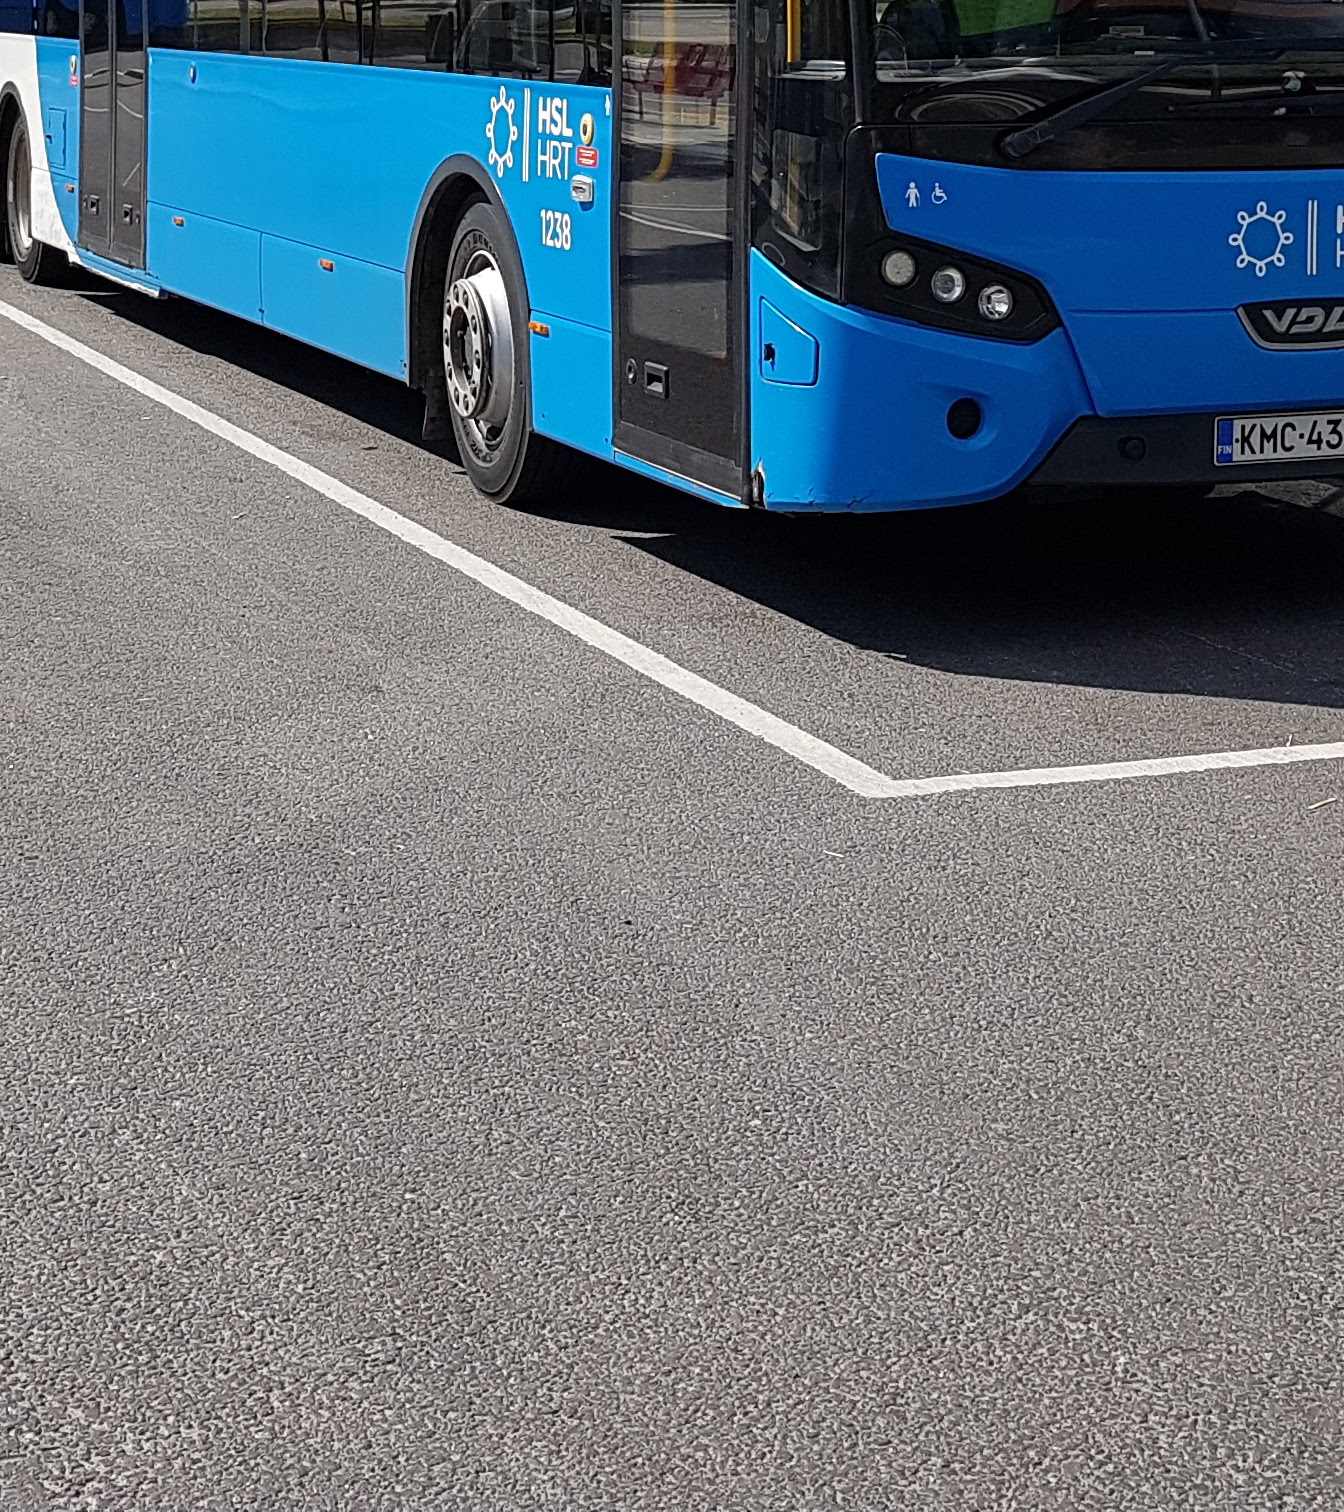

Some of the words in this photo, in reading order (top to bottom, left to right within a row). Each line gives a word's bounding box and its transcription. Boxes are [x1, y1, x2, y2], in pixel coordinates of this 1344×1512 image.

[537, 96, 574, 137] HSL
[537, 138, 574, 181] HRT
[540, 208, 572, 251] 1238
[1217, 445, 1232, 455] FIN
